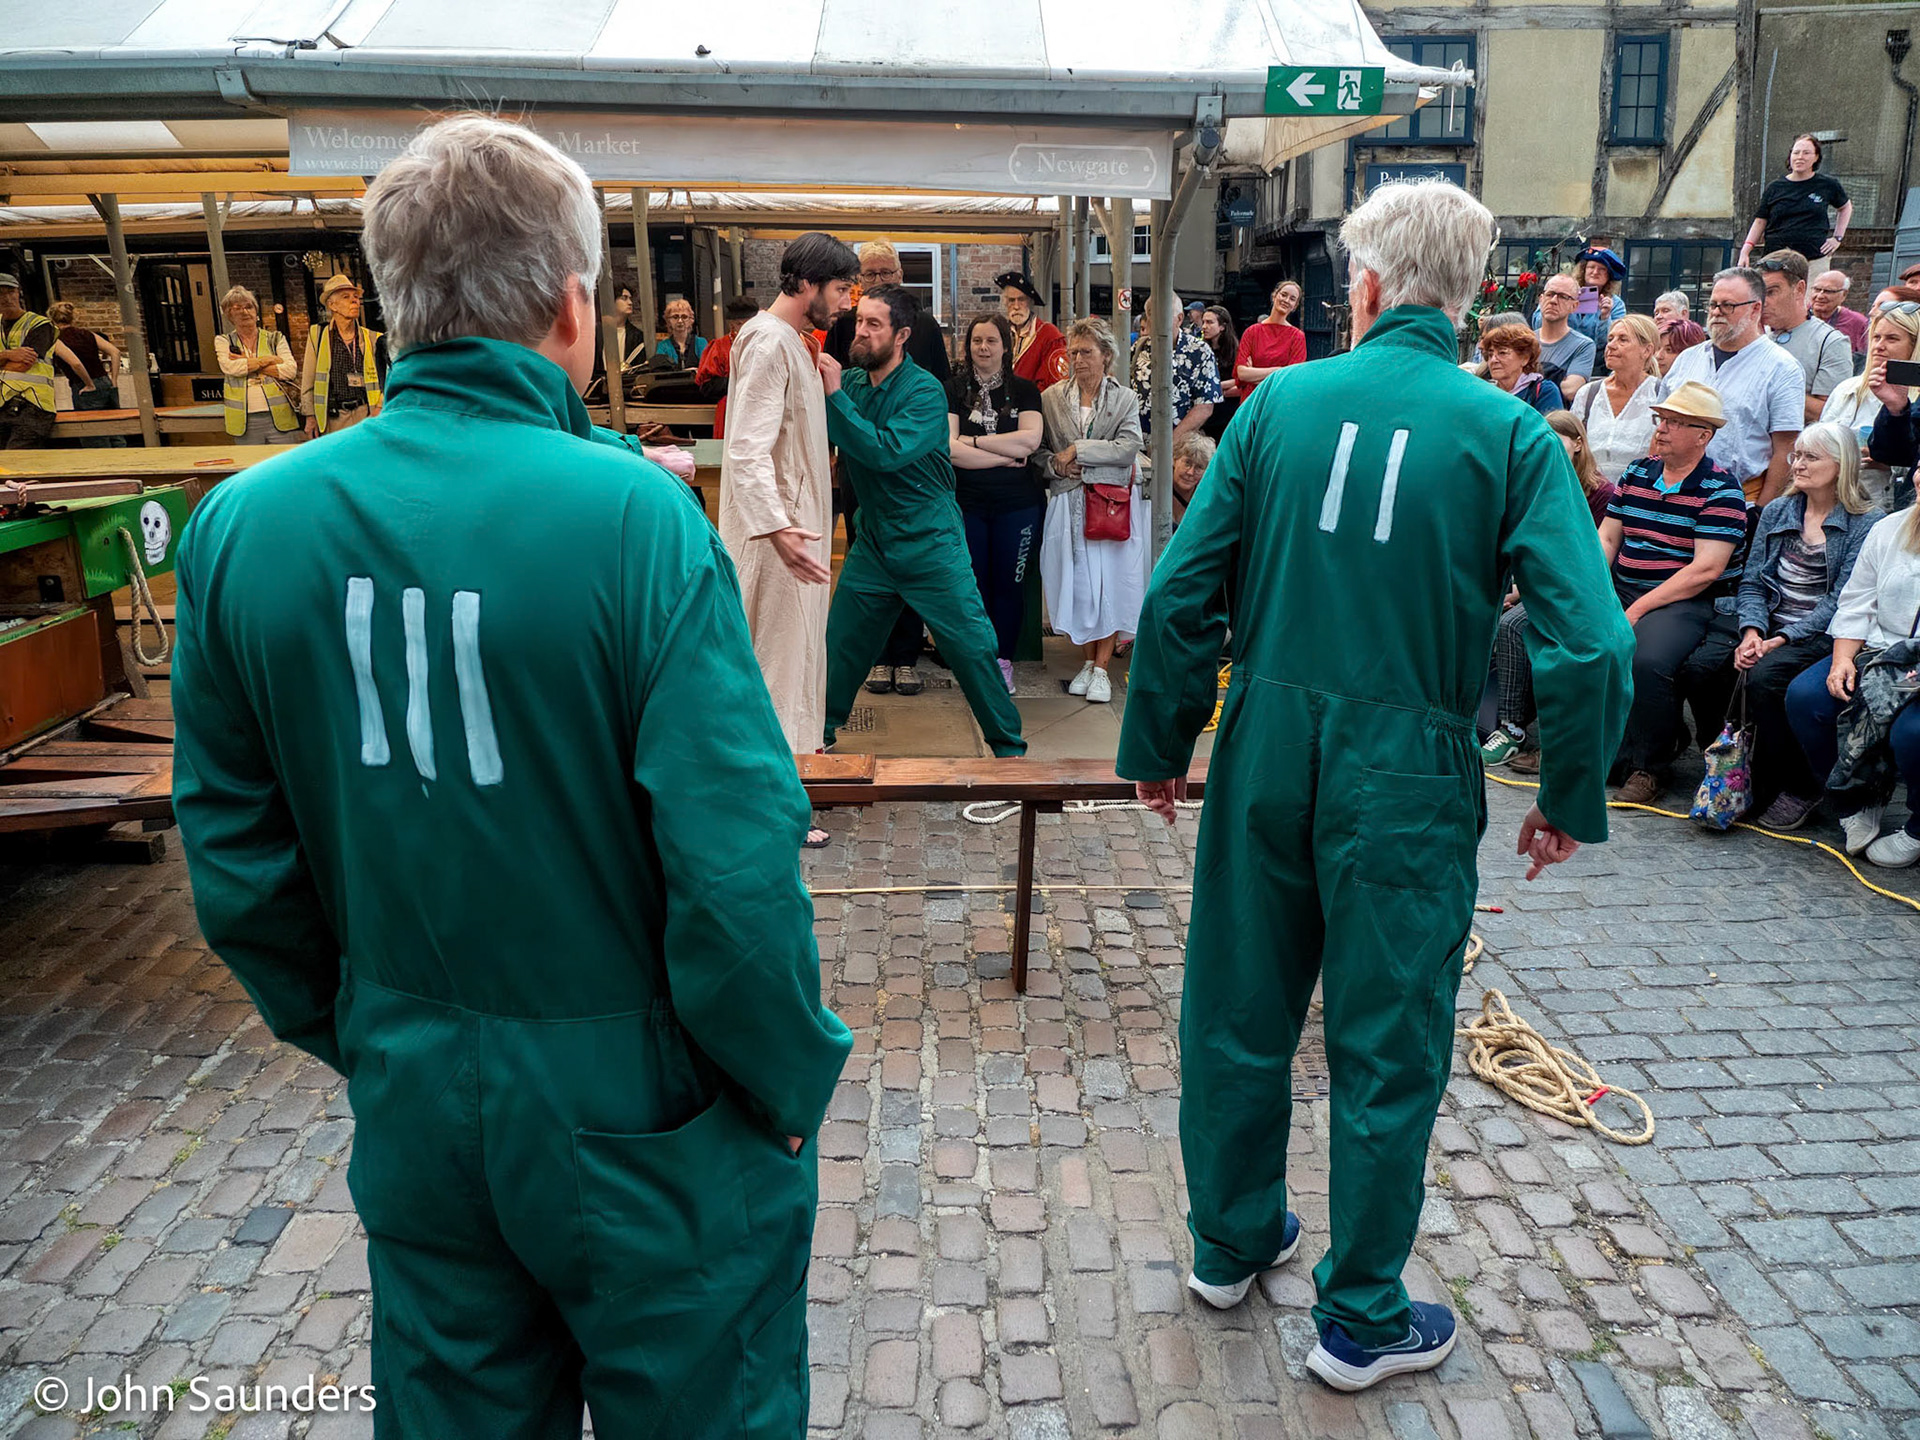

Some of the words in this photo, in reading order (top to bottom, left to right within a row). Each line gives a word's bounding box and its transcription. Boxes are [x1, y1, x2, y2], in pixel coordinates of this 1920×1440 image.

[304, 126, 409, 150] Welcome
[556, 131, 641, 155] Market
[1036, 152, 1129, 180] Newgate
[201, 390, 224, 399] SHA
